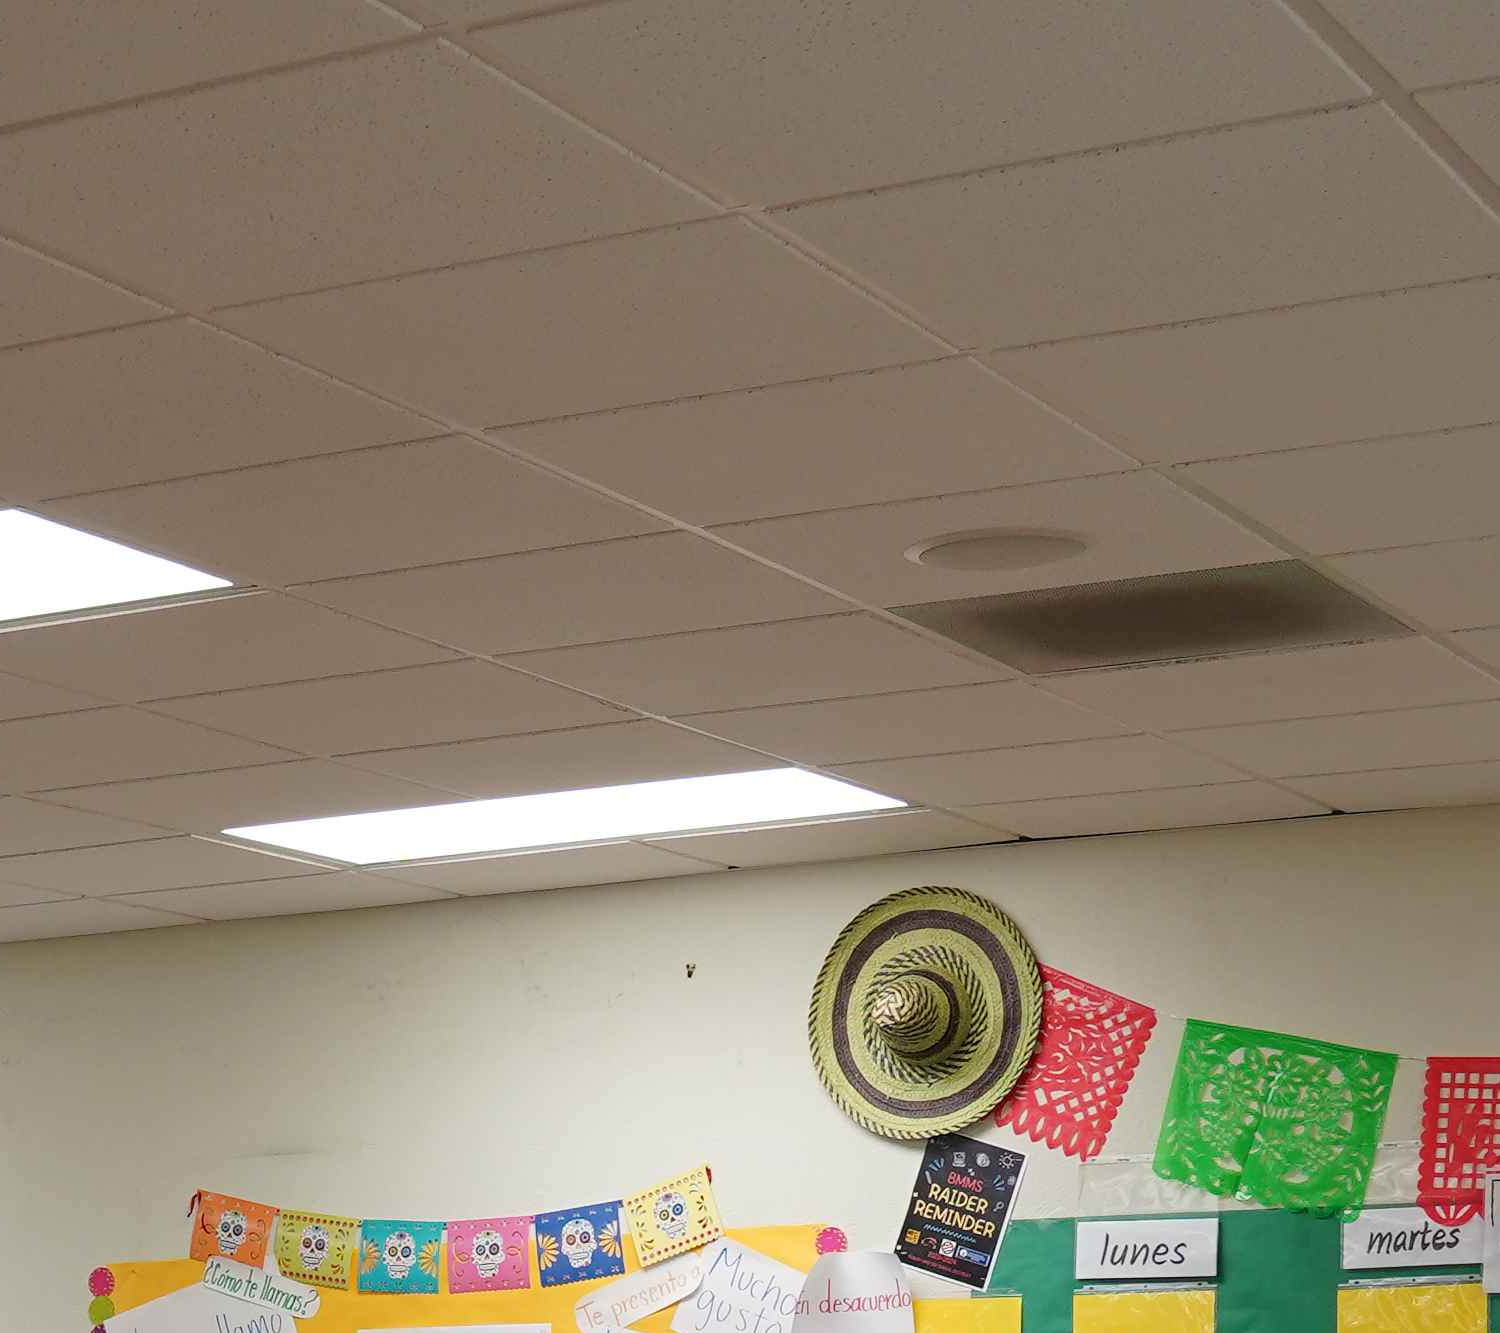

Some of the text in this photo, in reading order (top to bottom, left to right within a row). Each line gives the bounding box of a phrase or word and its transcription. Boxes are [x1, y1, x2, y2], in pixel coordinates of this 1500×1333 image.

[928, 1183, 989, 1214] RAIDER
[947, 1171, 984, 1192] BMMS
[913, 1200, 996, 1238] REMINDER
[1100, 1232, 1188, 1266] lunes
[1368, 1222, 1461, 1254] martes
[204, 1260, 318, 1315] ¿Cómo te llamas?
[709, 1248, 797, 1316] Mucho
[819, 1279, 912, 1314] desacuerdo
[575, 1302, 603, 1329] Te
[611, 1272, 687, 1322] presento
